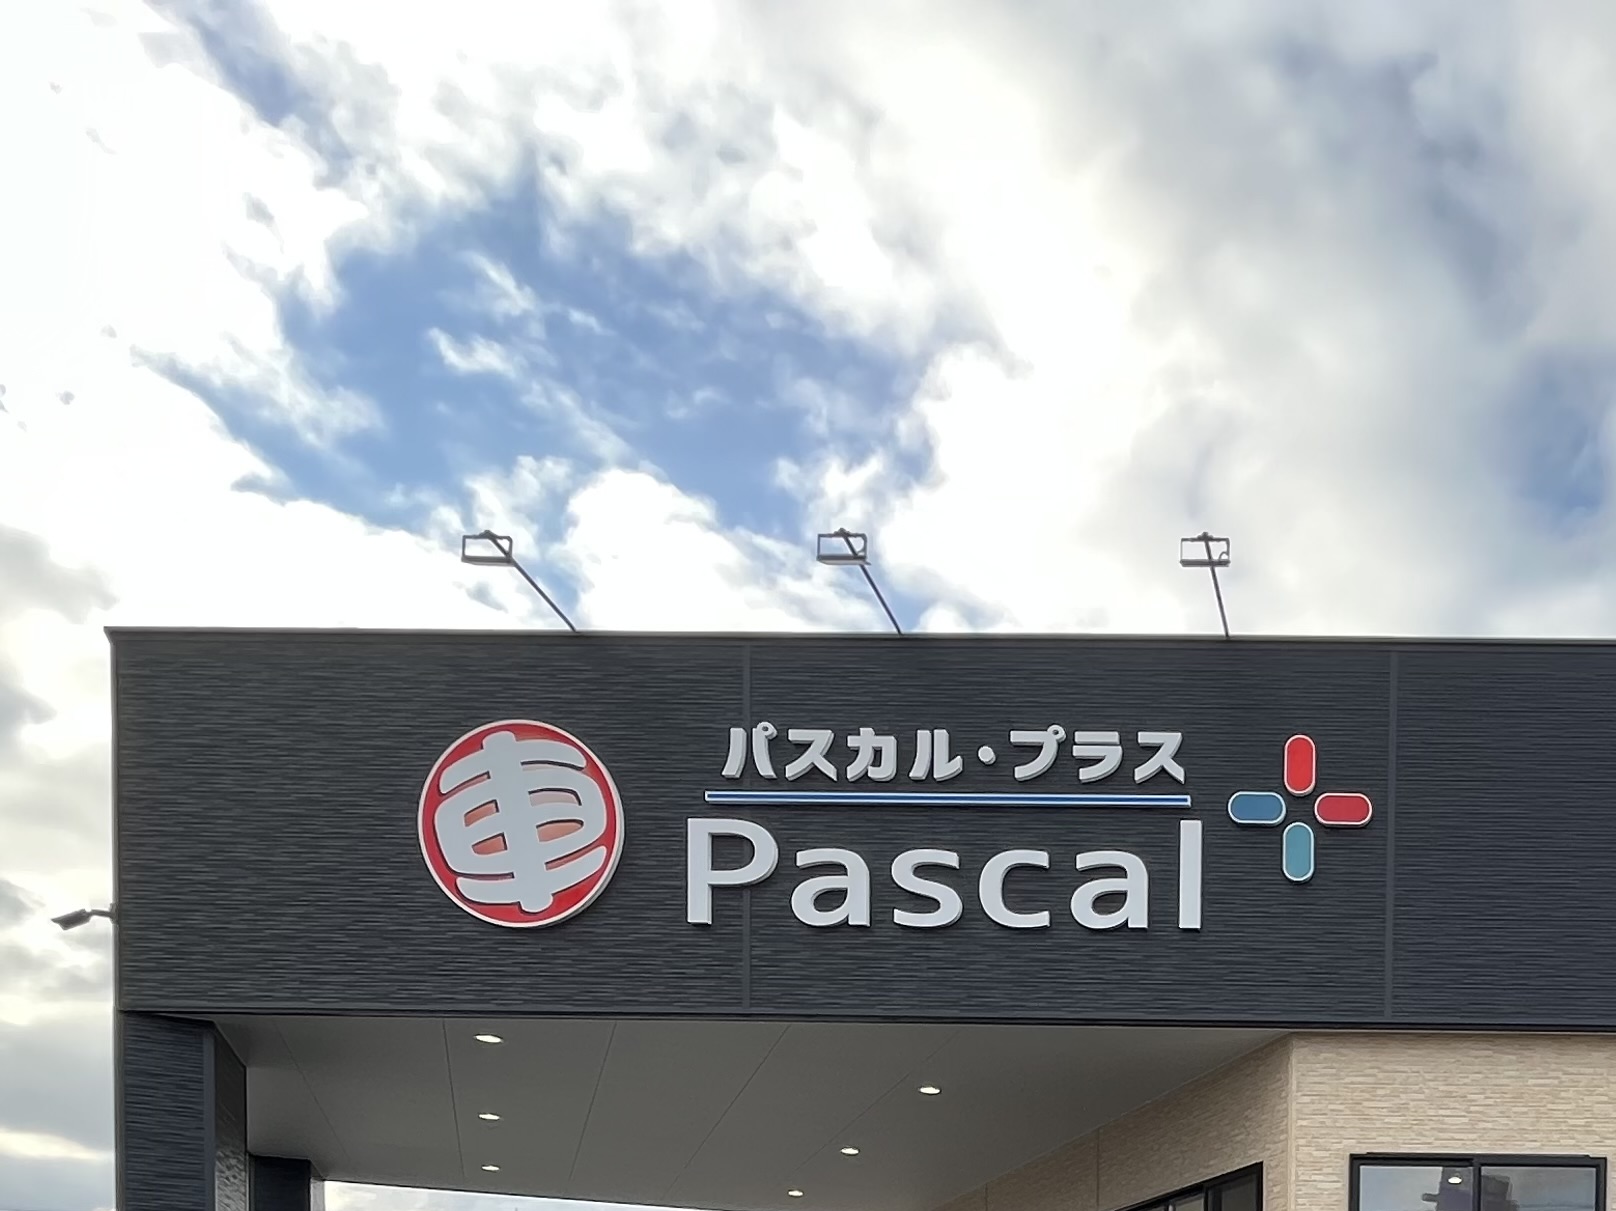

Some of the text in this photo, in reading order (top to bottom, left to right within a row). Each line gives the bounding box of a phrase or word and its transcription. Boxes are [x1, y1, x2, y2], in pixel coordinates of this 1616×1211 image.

[721, 721, 1186, 784] パスカル・プラス
[433, 731, 608, 914] 車
[685, 816, 1203, 931] Pascal
